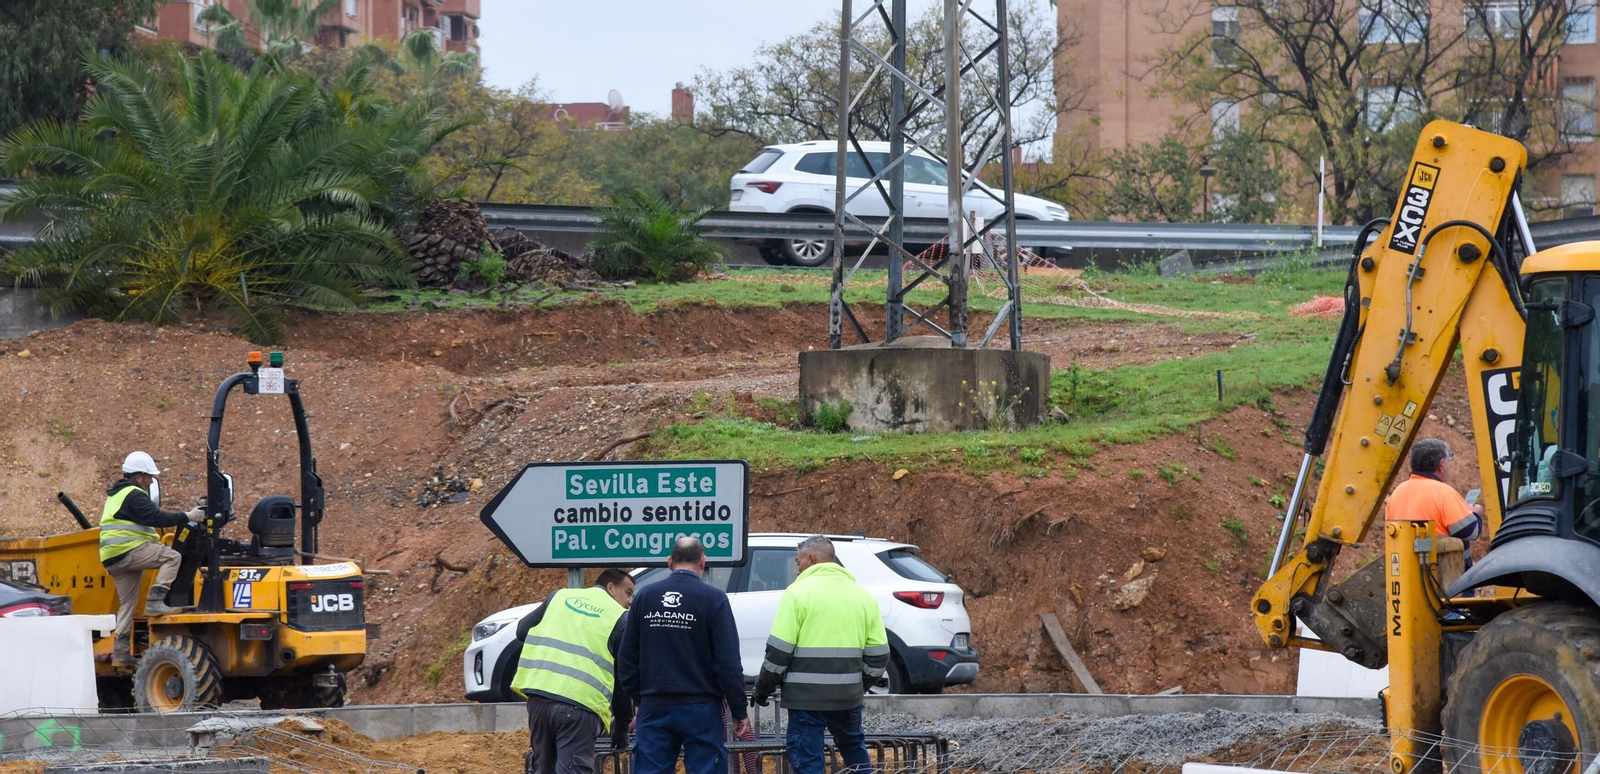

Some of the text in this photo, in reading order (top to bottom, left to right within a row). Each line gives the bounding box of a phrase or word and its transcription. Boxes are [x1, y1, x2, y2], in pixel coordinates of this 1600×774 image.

[1419, 170, 1432, 182] JCB
[1393, 187, 1430, 244] 3CX
[569, 472, 714, 496] Sevilla Este
[553, 500, 732, 524] cambio sentido
[554, 529, 597, 551] Pal.
[311, 593, 355, 613] JCB
[573, 598, 606, 614] Fycsur
[1391, 581, 1401, 637] M45
